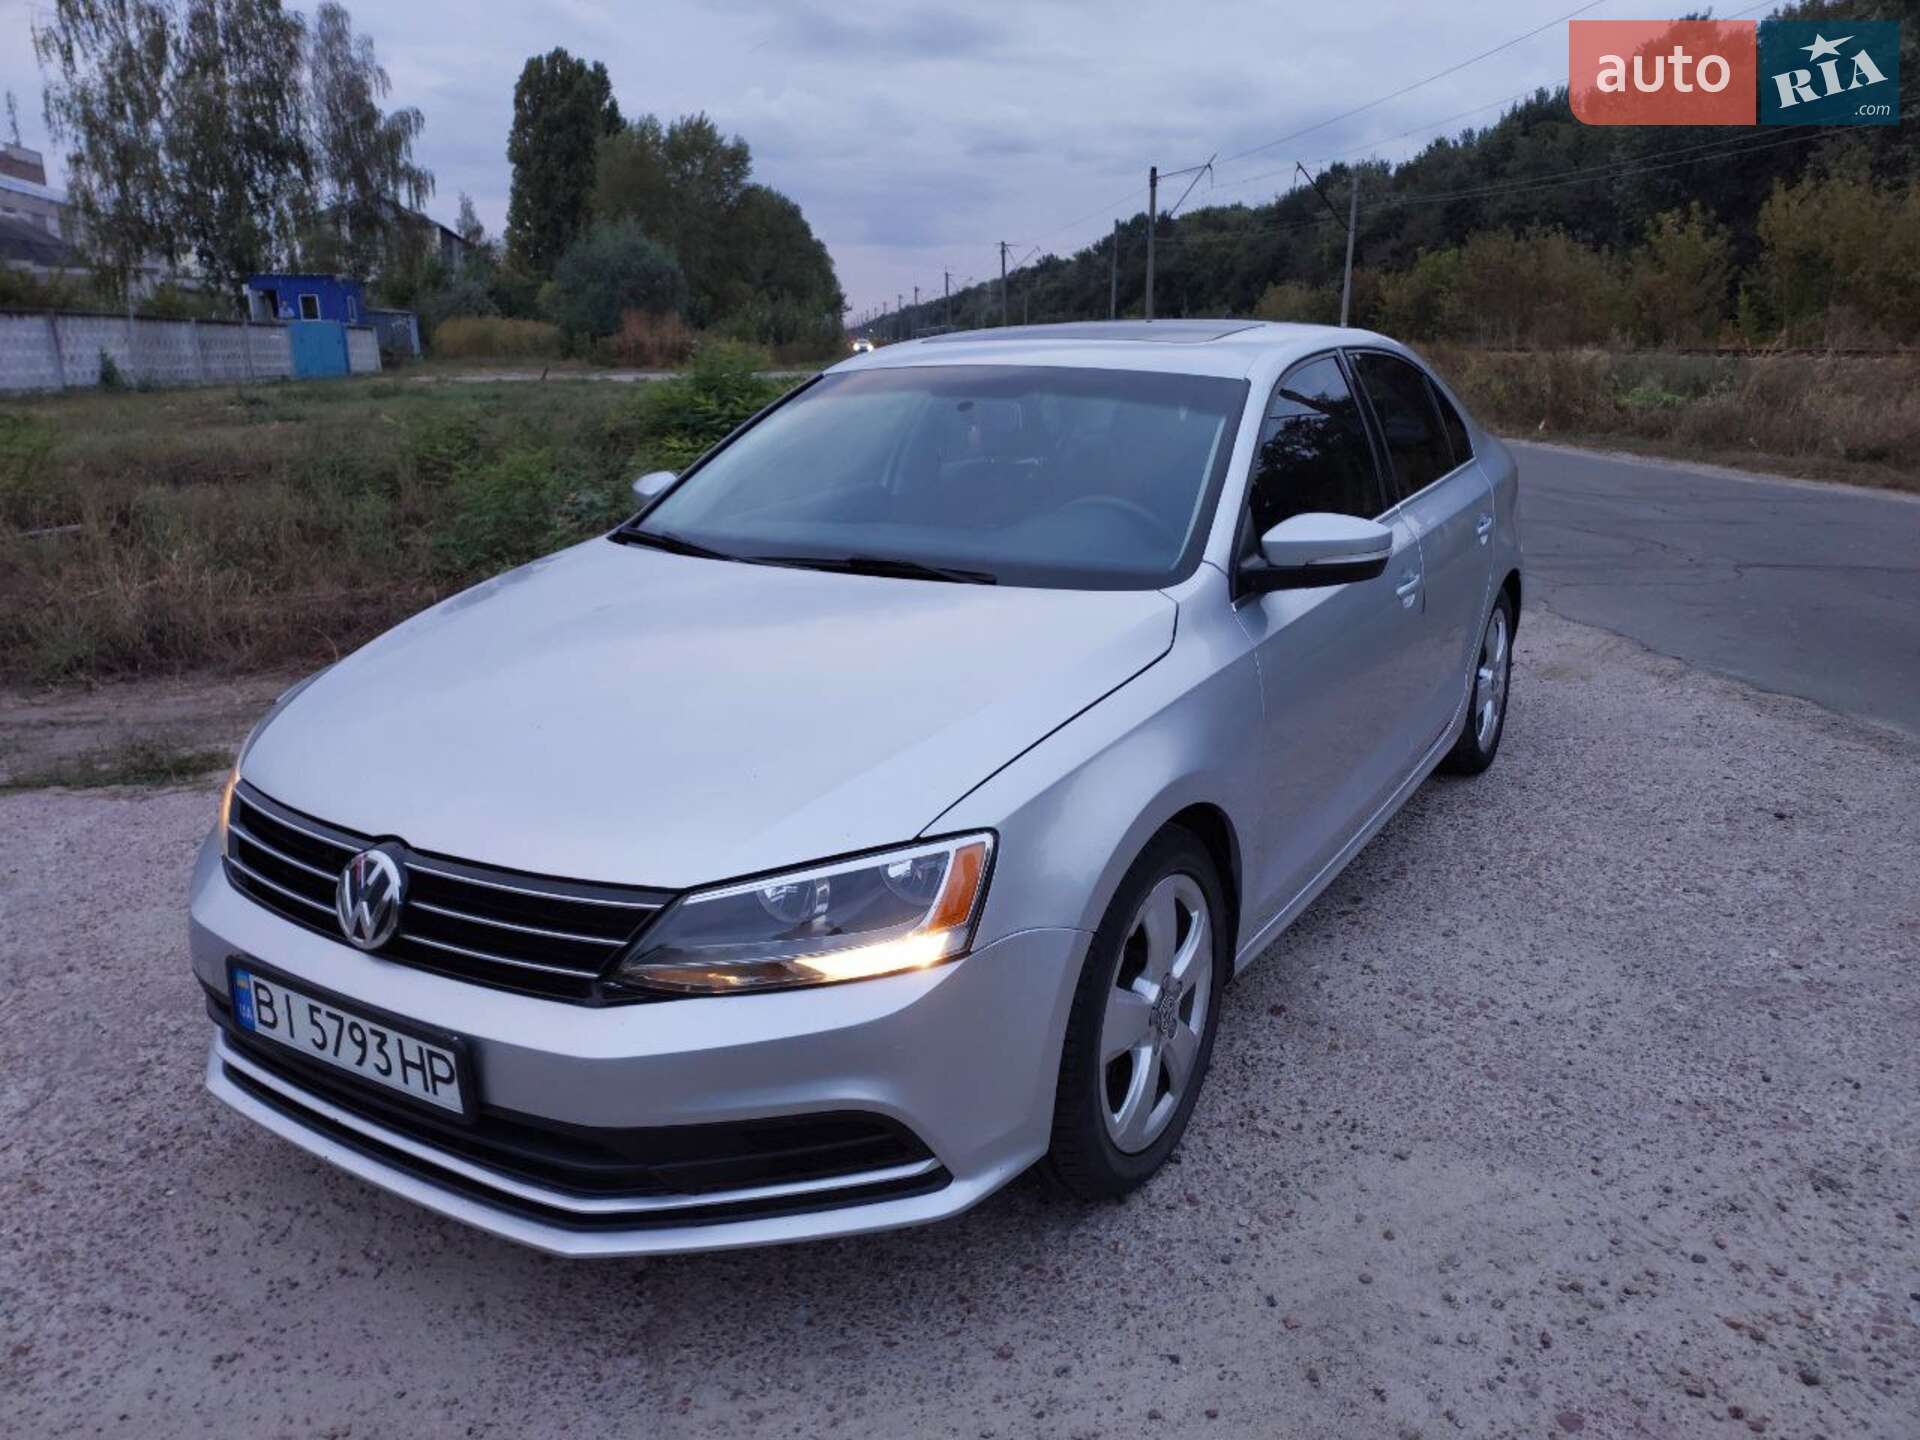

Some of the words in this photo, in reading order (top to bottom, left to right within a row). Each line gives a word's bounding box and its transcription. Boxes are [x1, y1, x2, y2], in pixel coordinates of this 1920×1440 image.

[253, 980, 295, 1038] BI
[308, 1003, 392, 1077] 5793
[397, 1038, 456, 1095] HP
